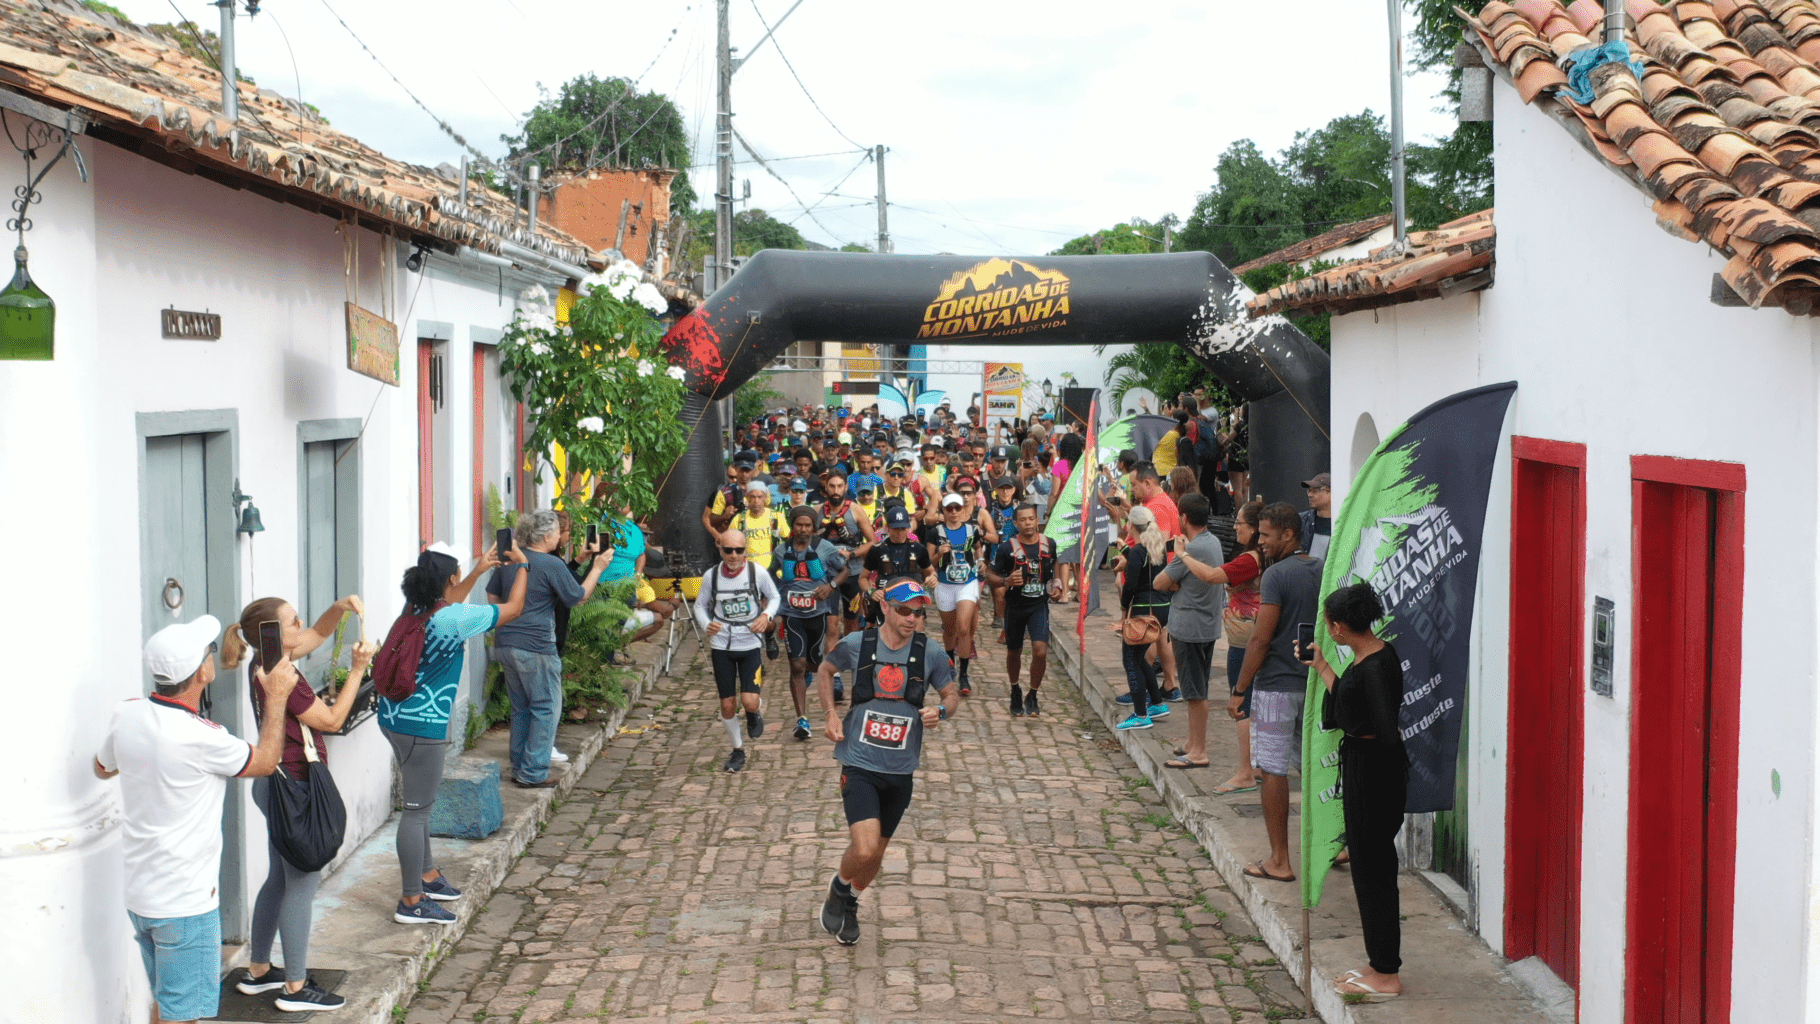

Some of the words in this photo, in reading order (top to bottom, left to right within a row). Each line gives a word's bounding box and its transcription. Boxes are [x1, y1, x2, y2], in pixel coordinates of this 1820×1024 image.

[1049, 281, 1071, 298] DE
[916, 295, 1071, 338] MONTANHA
[1369, 520, 1434, 596] RIDAS
[1432, 509, 1452, 536] DE
[949, 569, 967, 579] 921
[1381, 524, 1464, 614] TANHA
[1024, 583, 1042, 593] 931
[724, 601, 748, 614] 905
[791, 597, 812, 608] 840
[869, 722, 902, 741] 838
